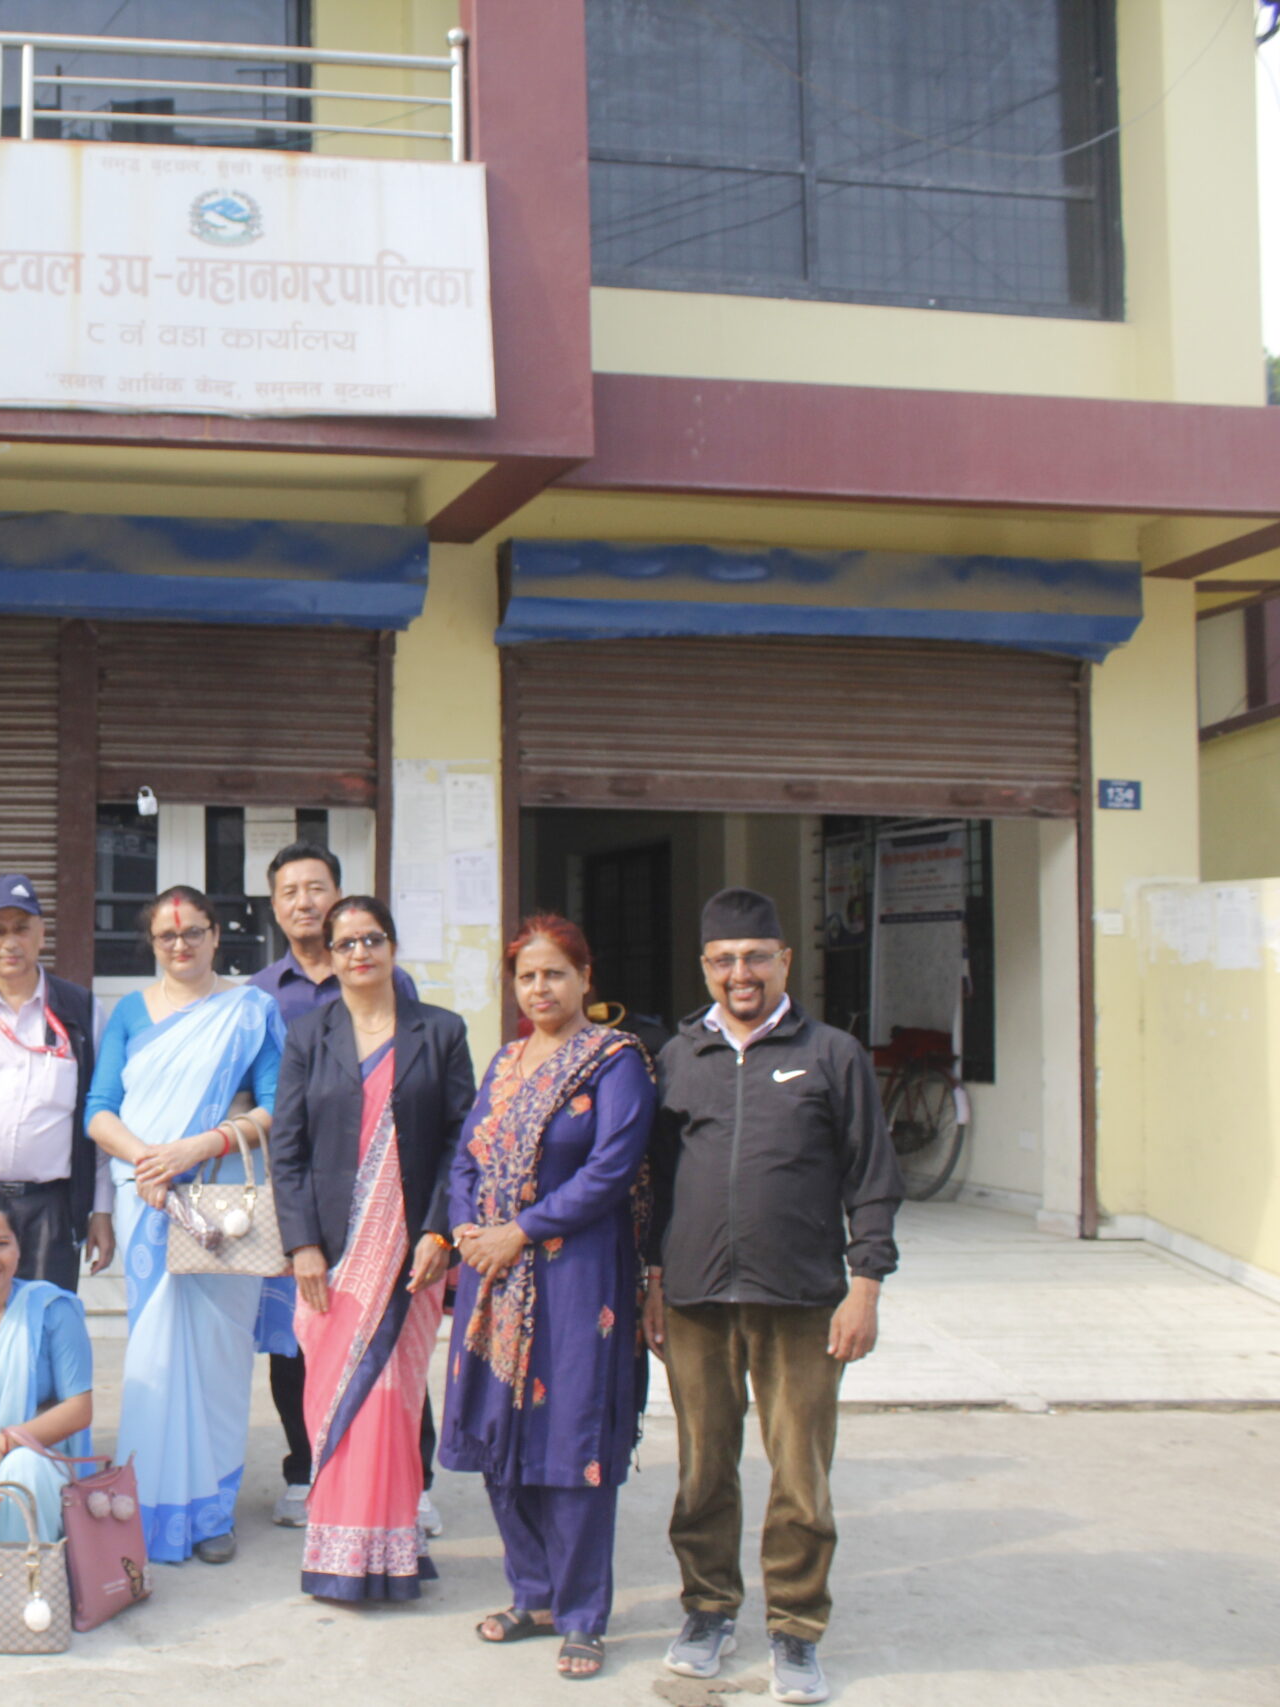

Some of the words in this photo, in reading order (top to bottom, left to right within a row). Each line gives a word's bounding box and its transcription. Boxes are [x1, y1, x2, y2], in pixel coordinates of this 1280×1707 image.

[98, 249, 475, 309] उप-महानगरपालिका
[158, 324, 208, 348] वडा
[220, 320, 360, 352] कार्यालय
